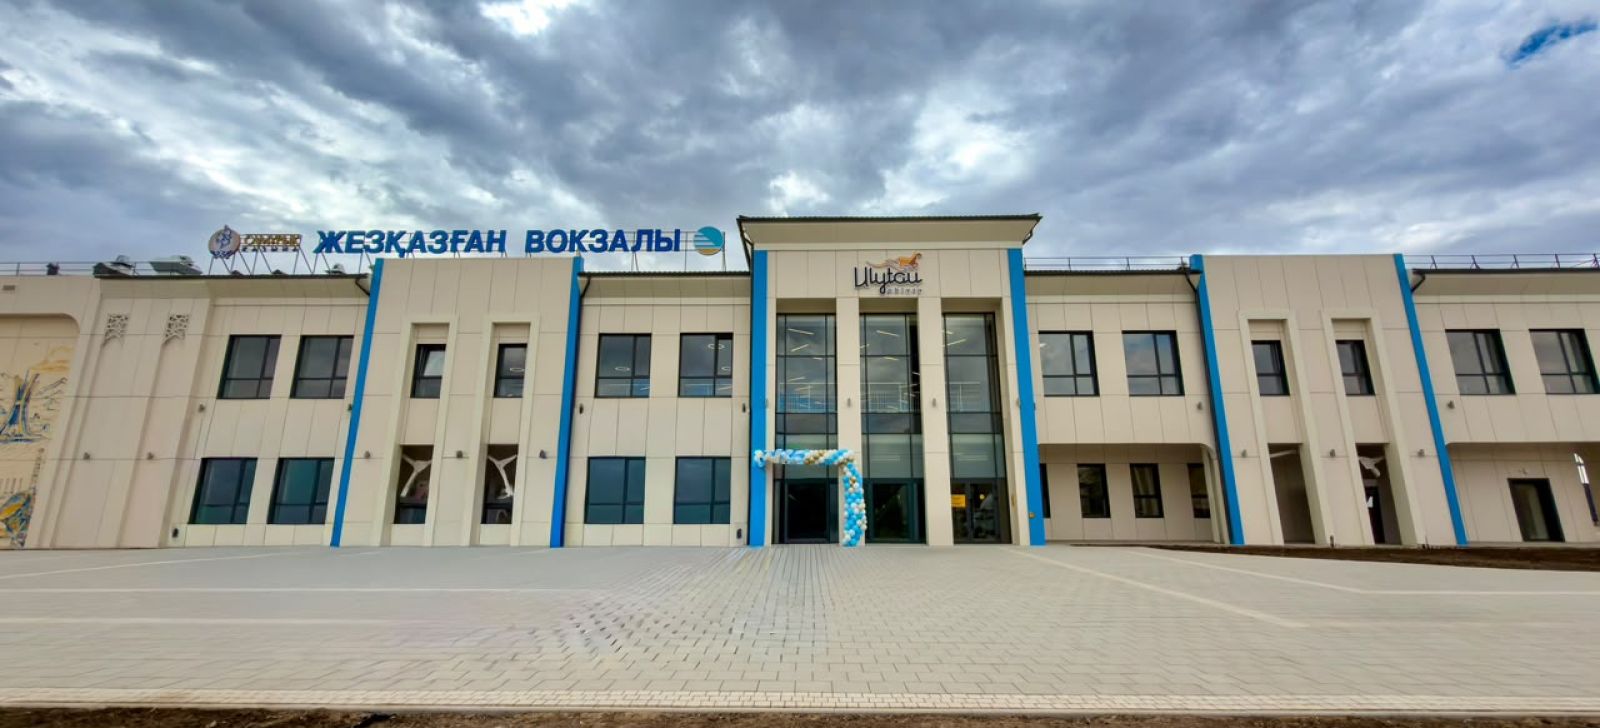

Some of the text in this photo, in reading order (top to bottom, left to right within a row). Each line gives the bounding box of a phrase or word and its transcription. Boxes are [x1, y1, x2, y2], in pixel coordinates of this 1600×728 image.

[313, 229, 507, 258] ЖЕЗҚАЗҒАН
[525, 228, 681, 253] ВОКЗАЛЫ
[854, 266, 923, 294] Ulytau
